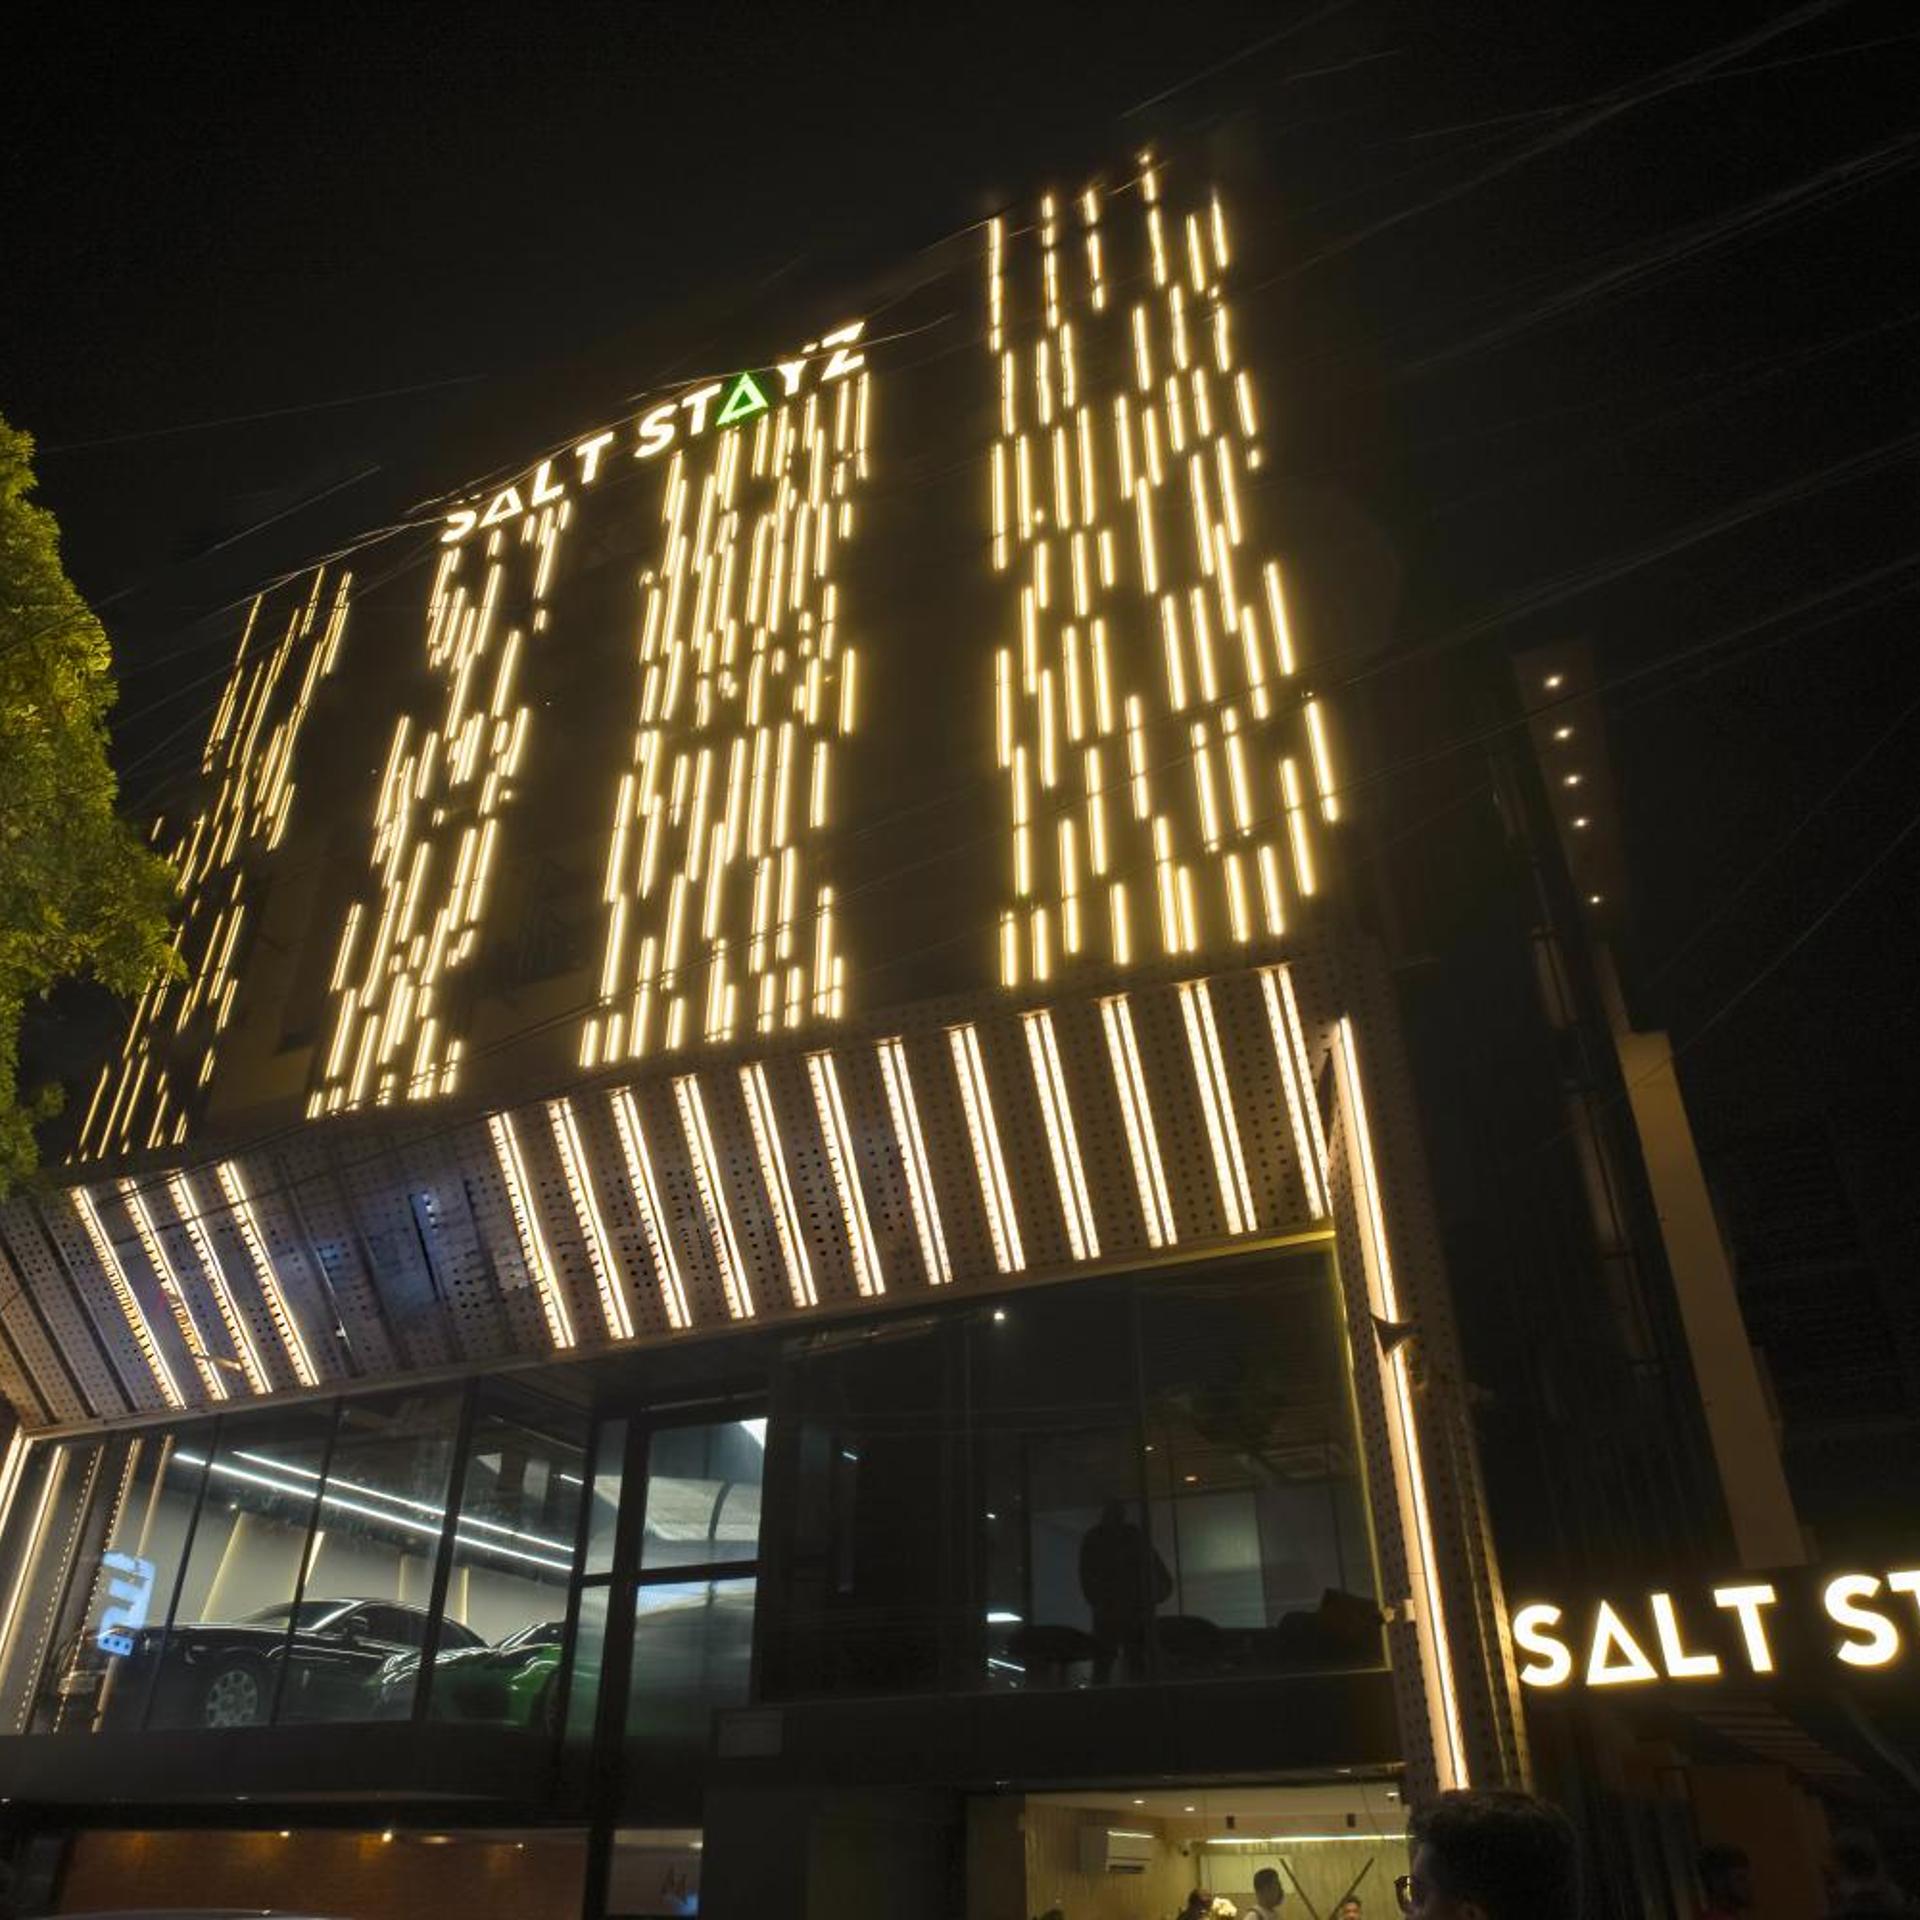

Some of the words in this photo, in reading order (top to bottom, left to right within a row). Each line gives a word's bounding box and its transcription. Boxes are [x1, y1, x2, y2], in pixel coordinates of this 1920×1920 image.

[441, 431, 614, 542] SALT
[633, 322, 865, 458] STAYZ
[1513, 1585, 1776, 1687] SALT
